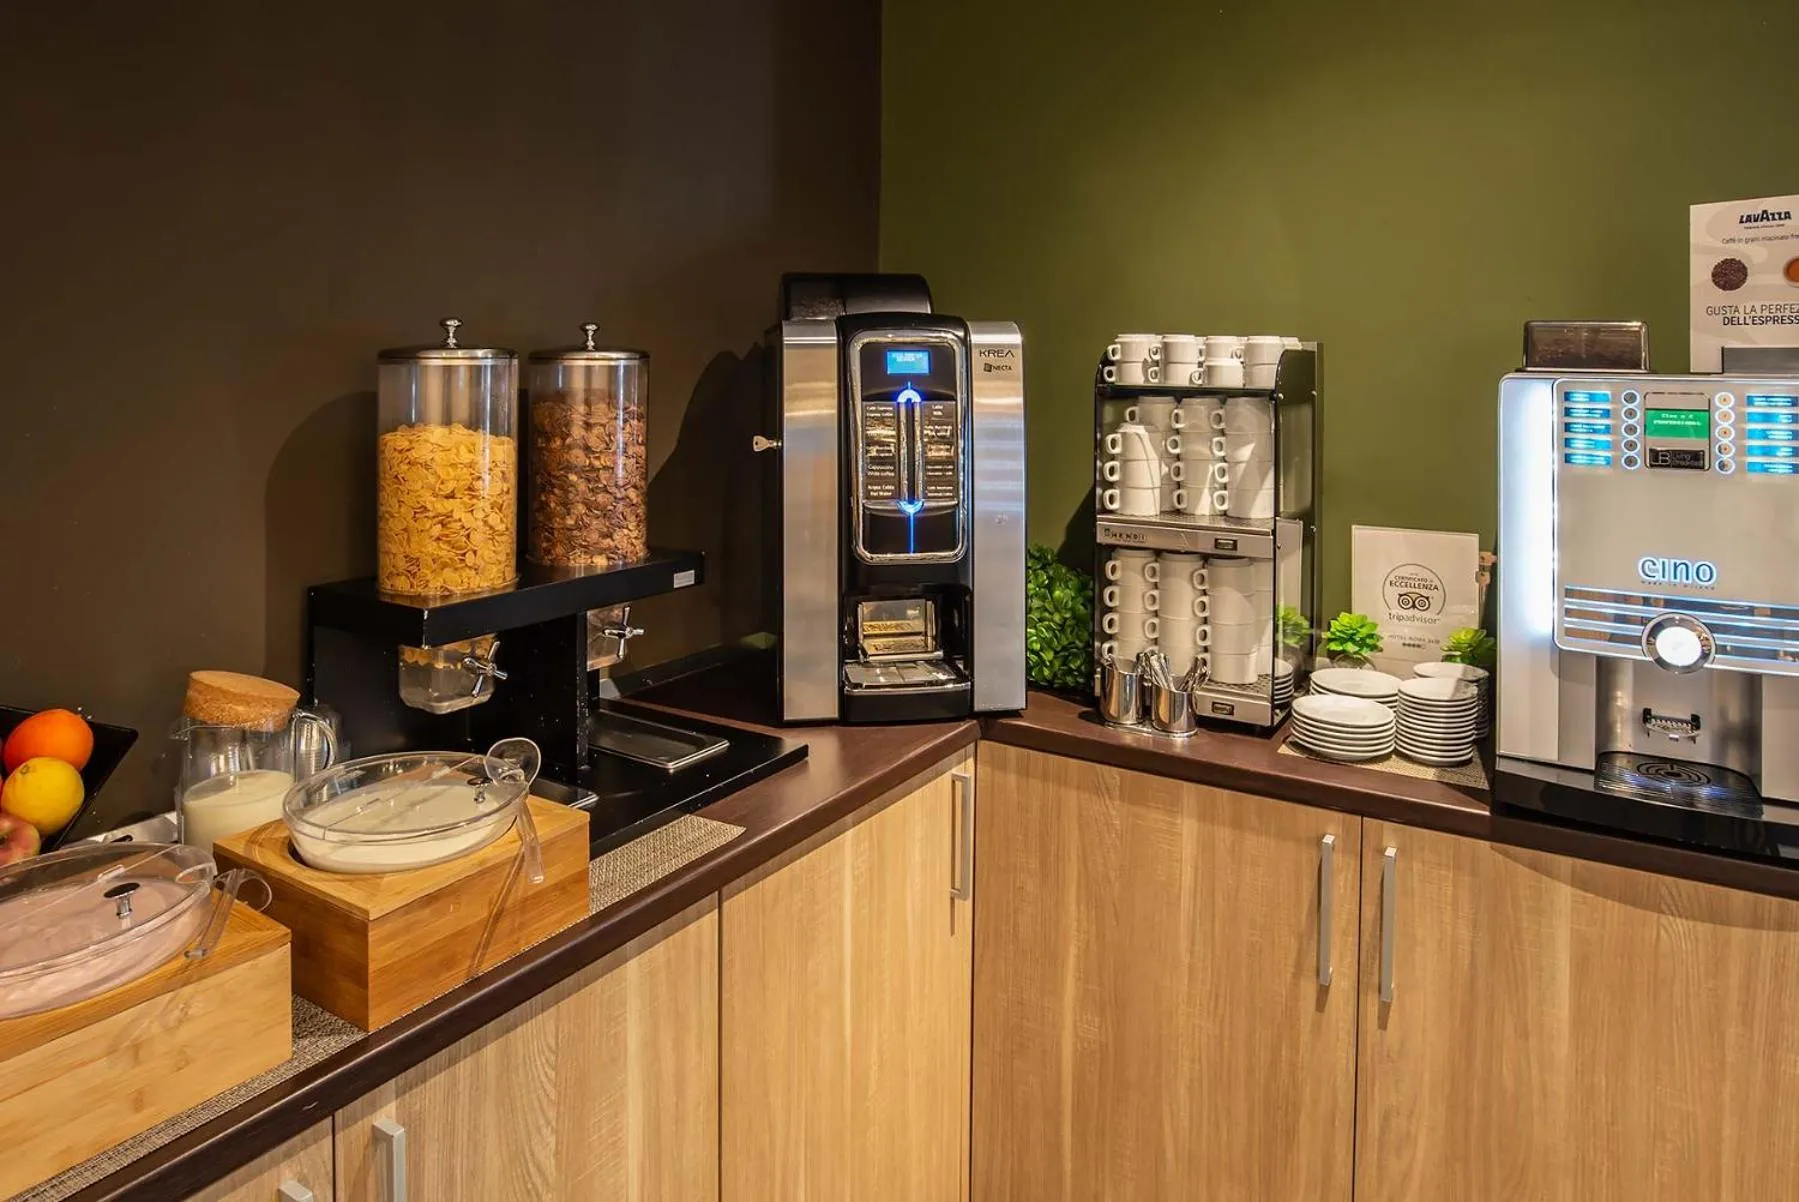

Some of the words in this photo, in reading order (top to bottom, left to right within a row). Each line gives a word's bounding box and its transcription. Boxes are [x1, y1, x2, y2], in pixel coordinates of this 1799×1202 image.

[1739, 209, 1792, 224] LAVAZZA
[1706, 304, 1741, 316] GUSTA
[1743, 304, 1758, 315] LA
[1389, 580, 1440, 591] ECCELLENZA
